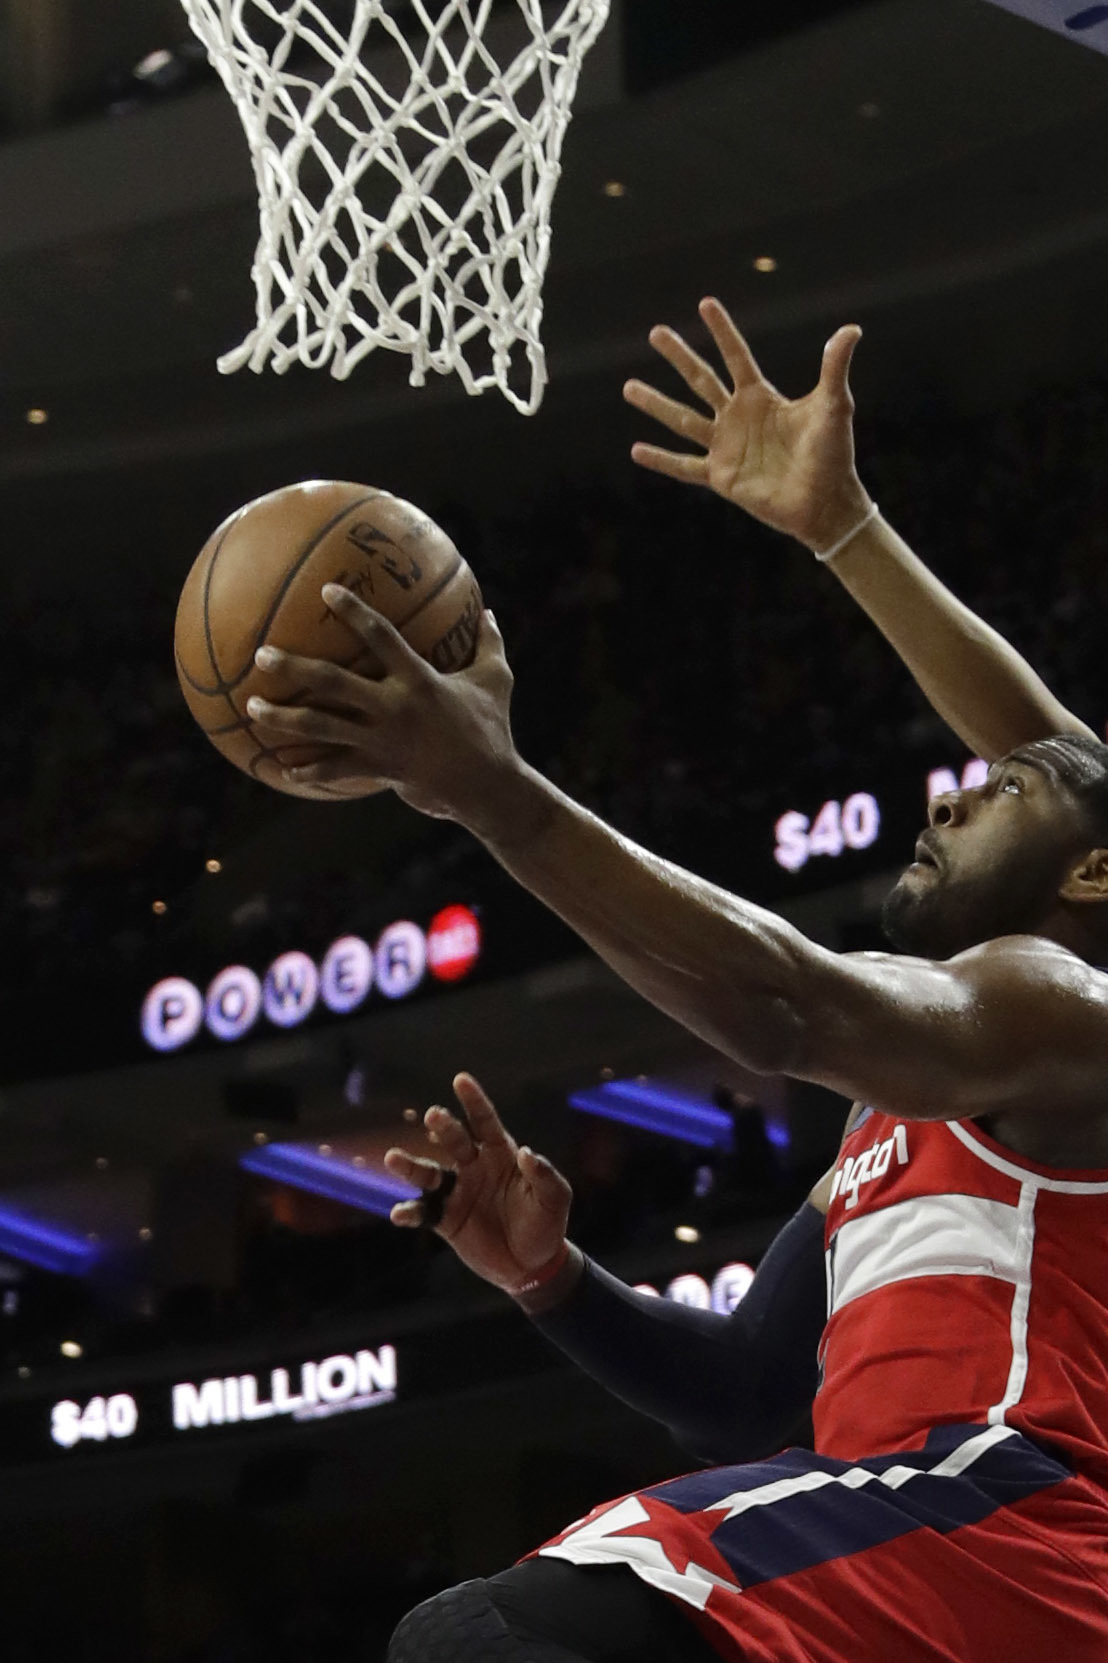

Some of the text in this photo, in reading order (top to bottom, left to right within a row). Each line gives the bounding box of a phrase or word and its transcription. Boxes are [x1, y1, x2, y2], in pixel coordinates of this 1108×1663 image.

[774, 791, 881, 873] $40
[51, 1344, 397, 1448] $40 MILLION
